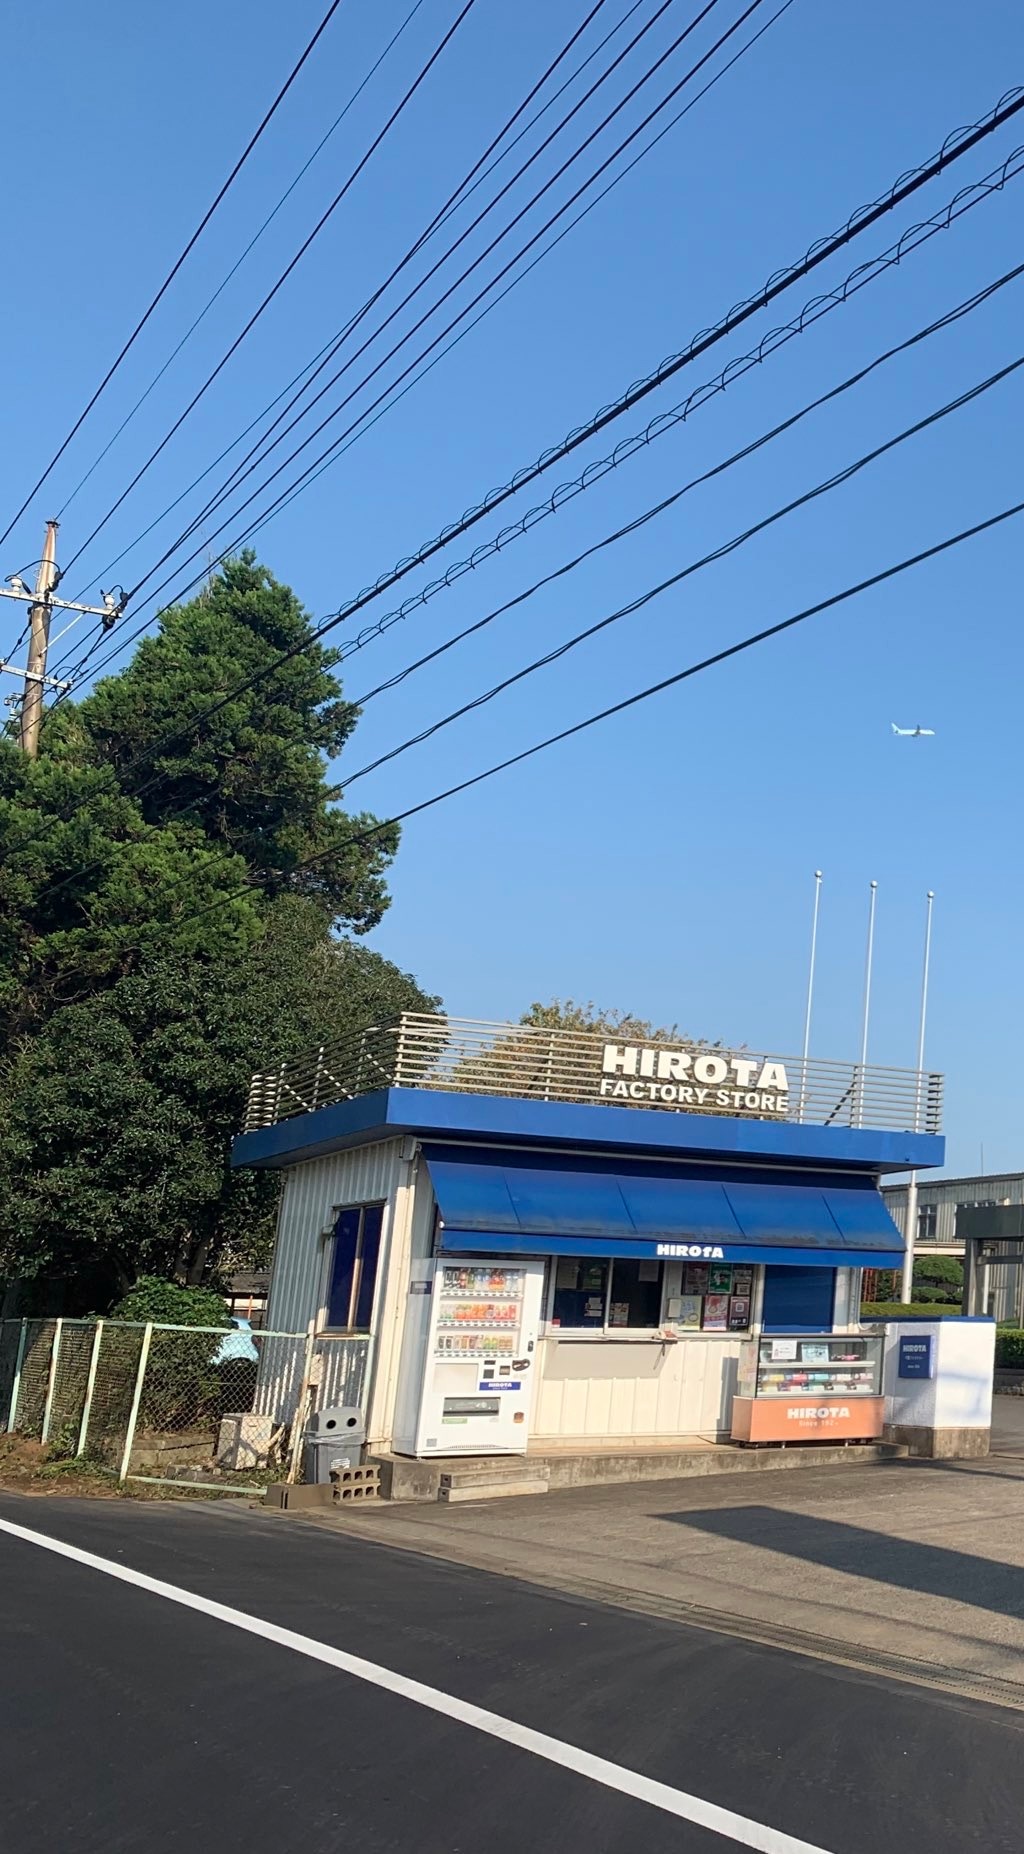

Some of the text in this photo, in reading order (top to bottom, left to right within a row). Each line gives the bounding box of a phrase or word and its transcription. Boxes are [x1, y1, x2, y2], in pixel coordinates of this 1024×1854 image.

[602, 1044, 789, 1091] HIROTA
[600, 1078, 789, 1112] FACTORY STORE
[657, 1244, 724, 1259] HIROTA
[902, 1344, 927, 1353] HIROTA
[787, 1407, 851, 1419] HIROTA
